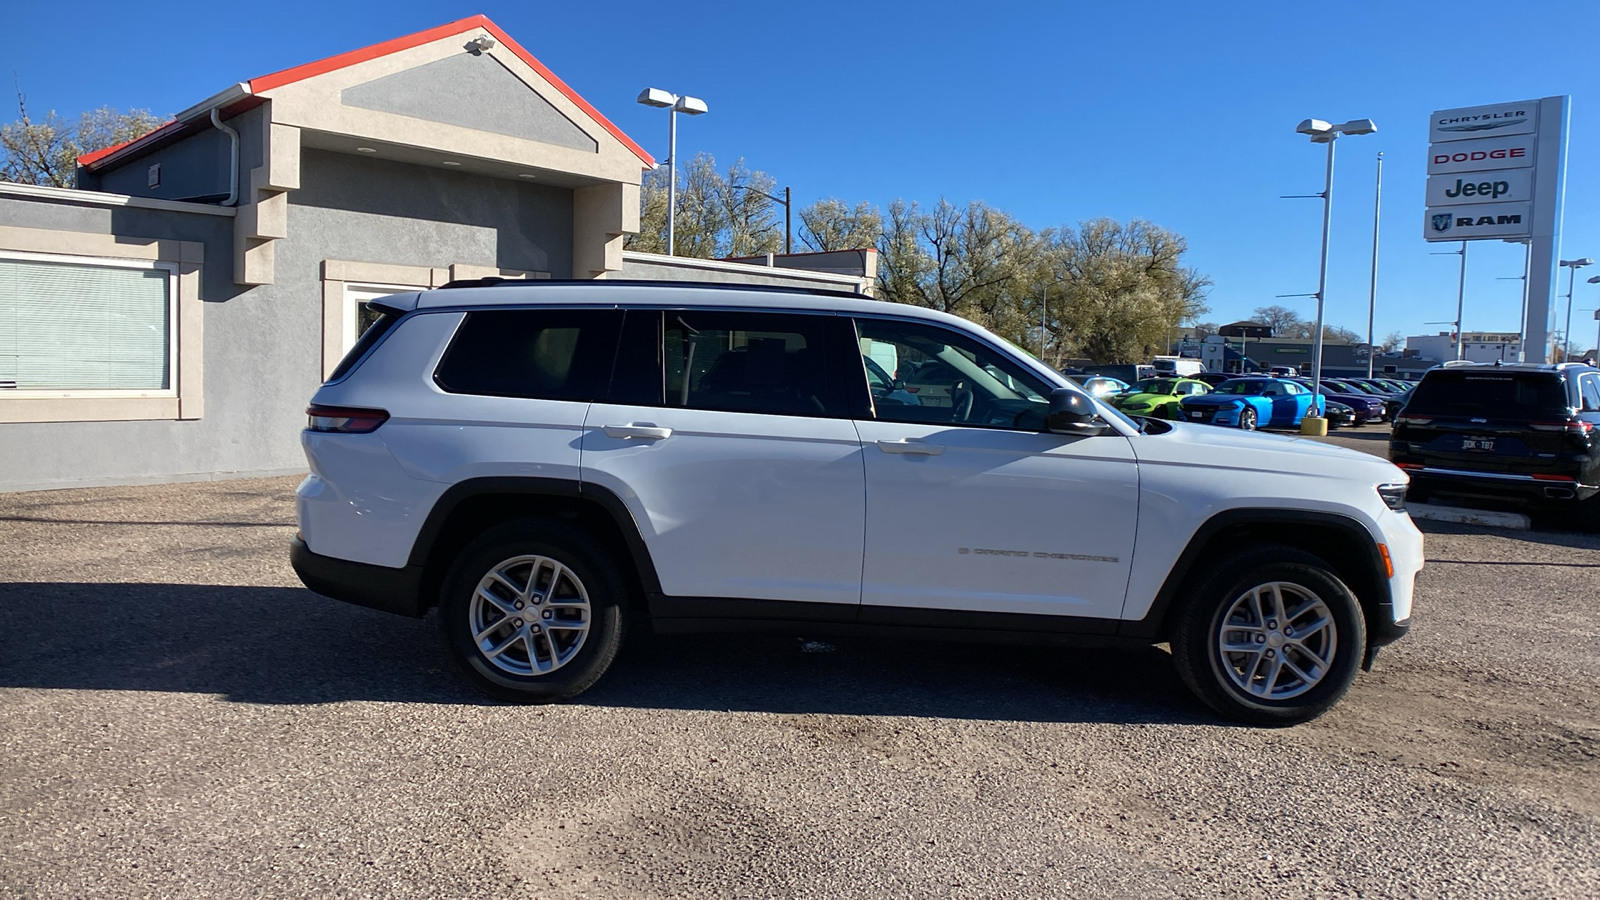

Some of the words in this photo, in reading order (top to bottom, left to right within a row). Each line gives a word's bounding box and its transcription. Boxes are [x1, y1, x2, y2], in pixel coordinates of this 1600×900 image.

[1439, 110, 1526, 124] CHRYSLER
[1434, 147, 1526, 165] DODGE
[1445, 179, 1509, 199] Jeep
[1456, 214, 1522, 227] RAM
[973, 548, 1029, 557] GRAND
[1033, 551, 1119, 562] CHEROKEE
